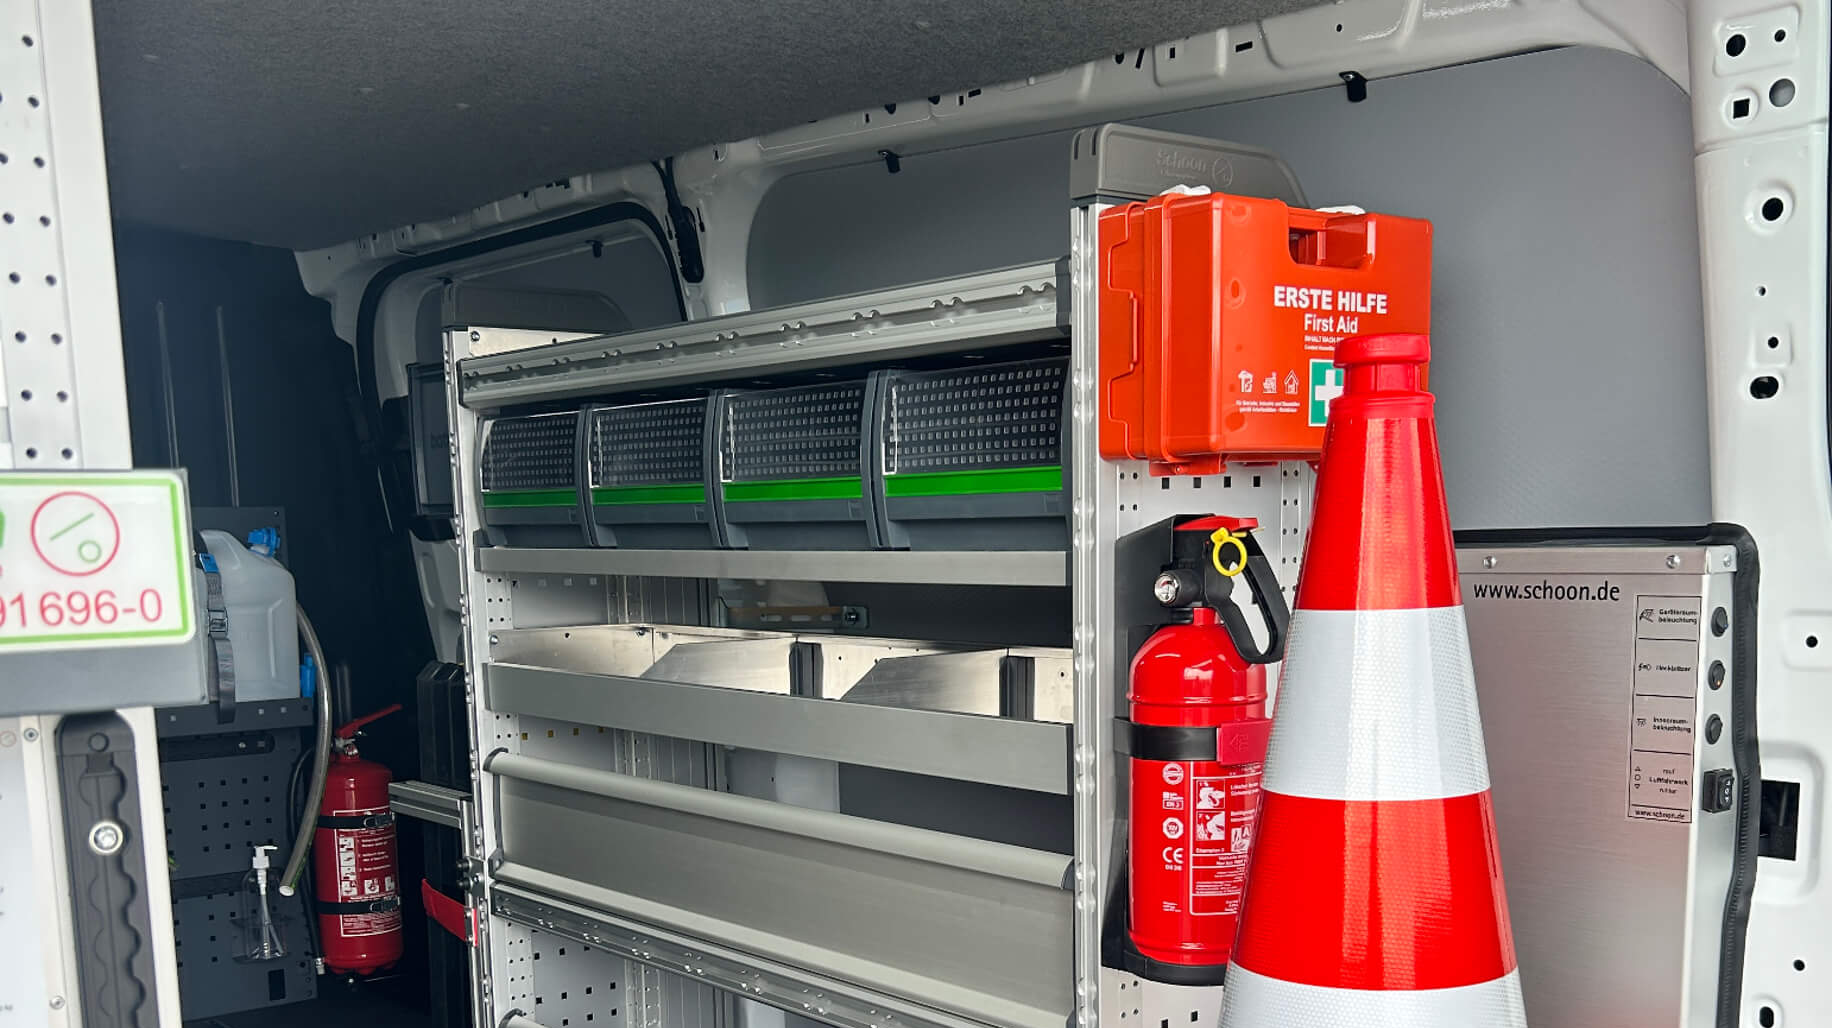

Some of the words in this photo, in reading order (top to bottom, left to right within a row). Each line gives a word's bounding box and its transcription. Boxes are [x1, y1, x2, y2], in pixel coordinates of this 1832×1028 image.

[1274, 285, 1333, 310] ERSTE
[1337, 290, 1388, 314] HILFE
[1304, 313, 1334, 333] First
[1336, 315, 1359, 334] Aid
[1473, 579, 1620, 601] www.schoon.de
[0, 588, 163, 628] 1696-0
